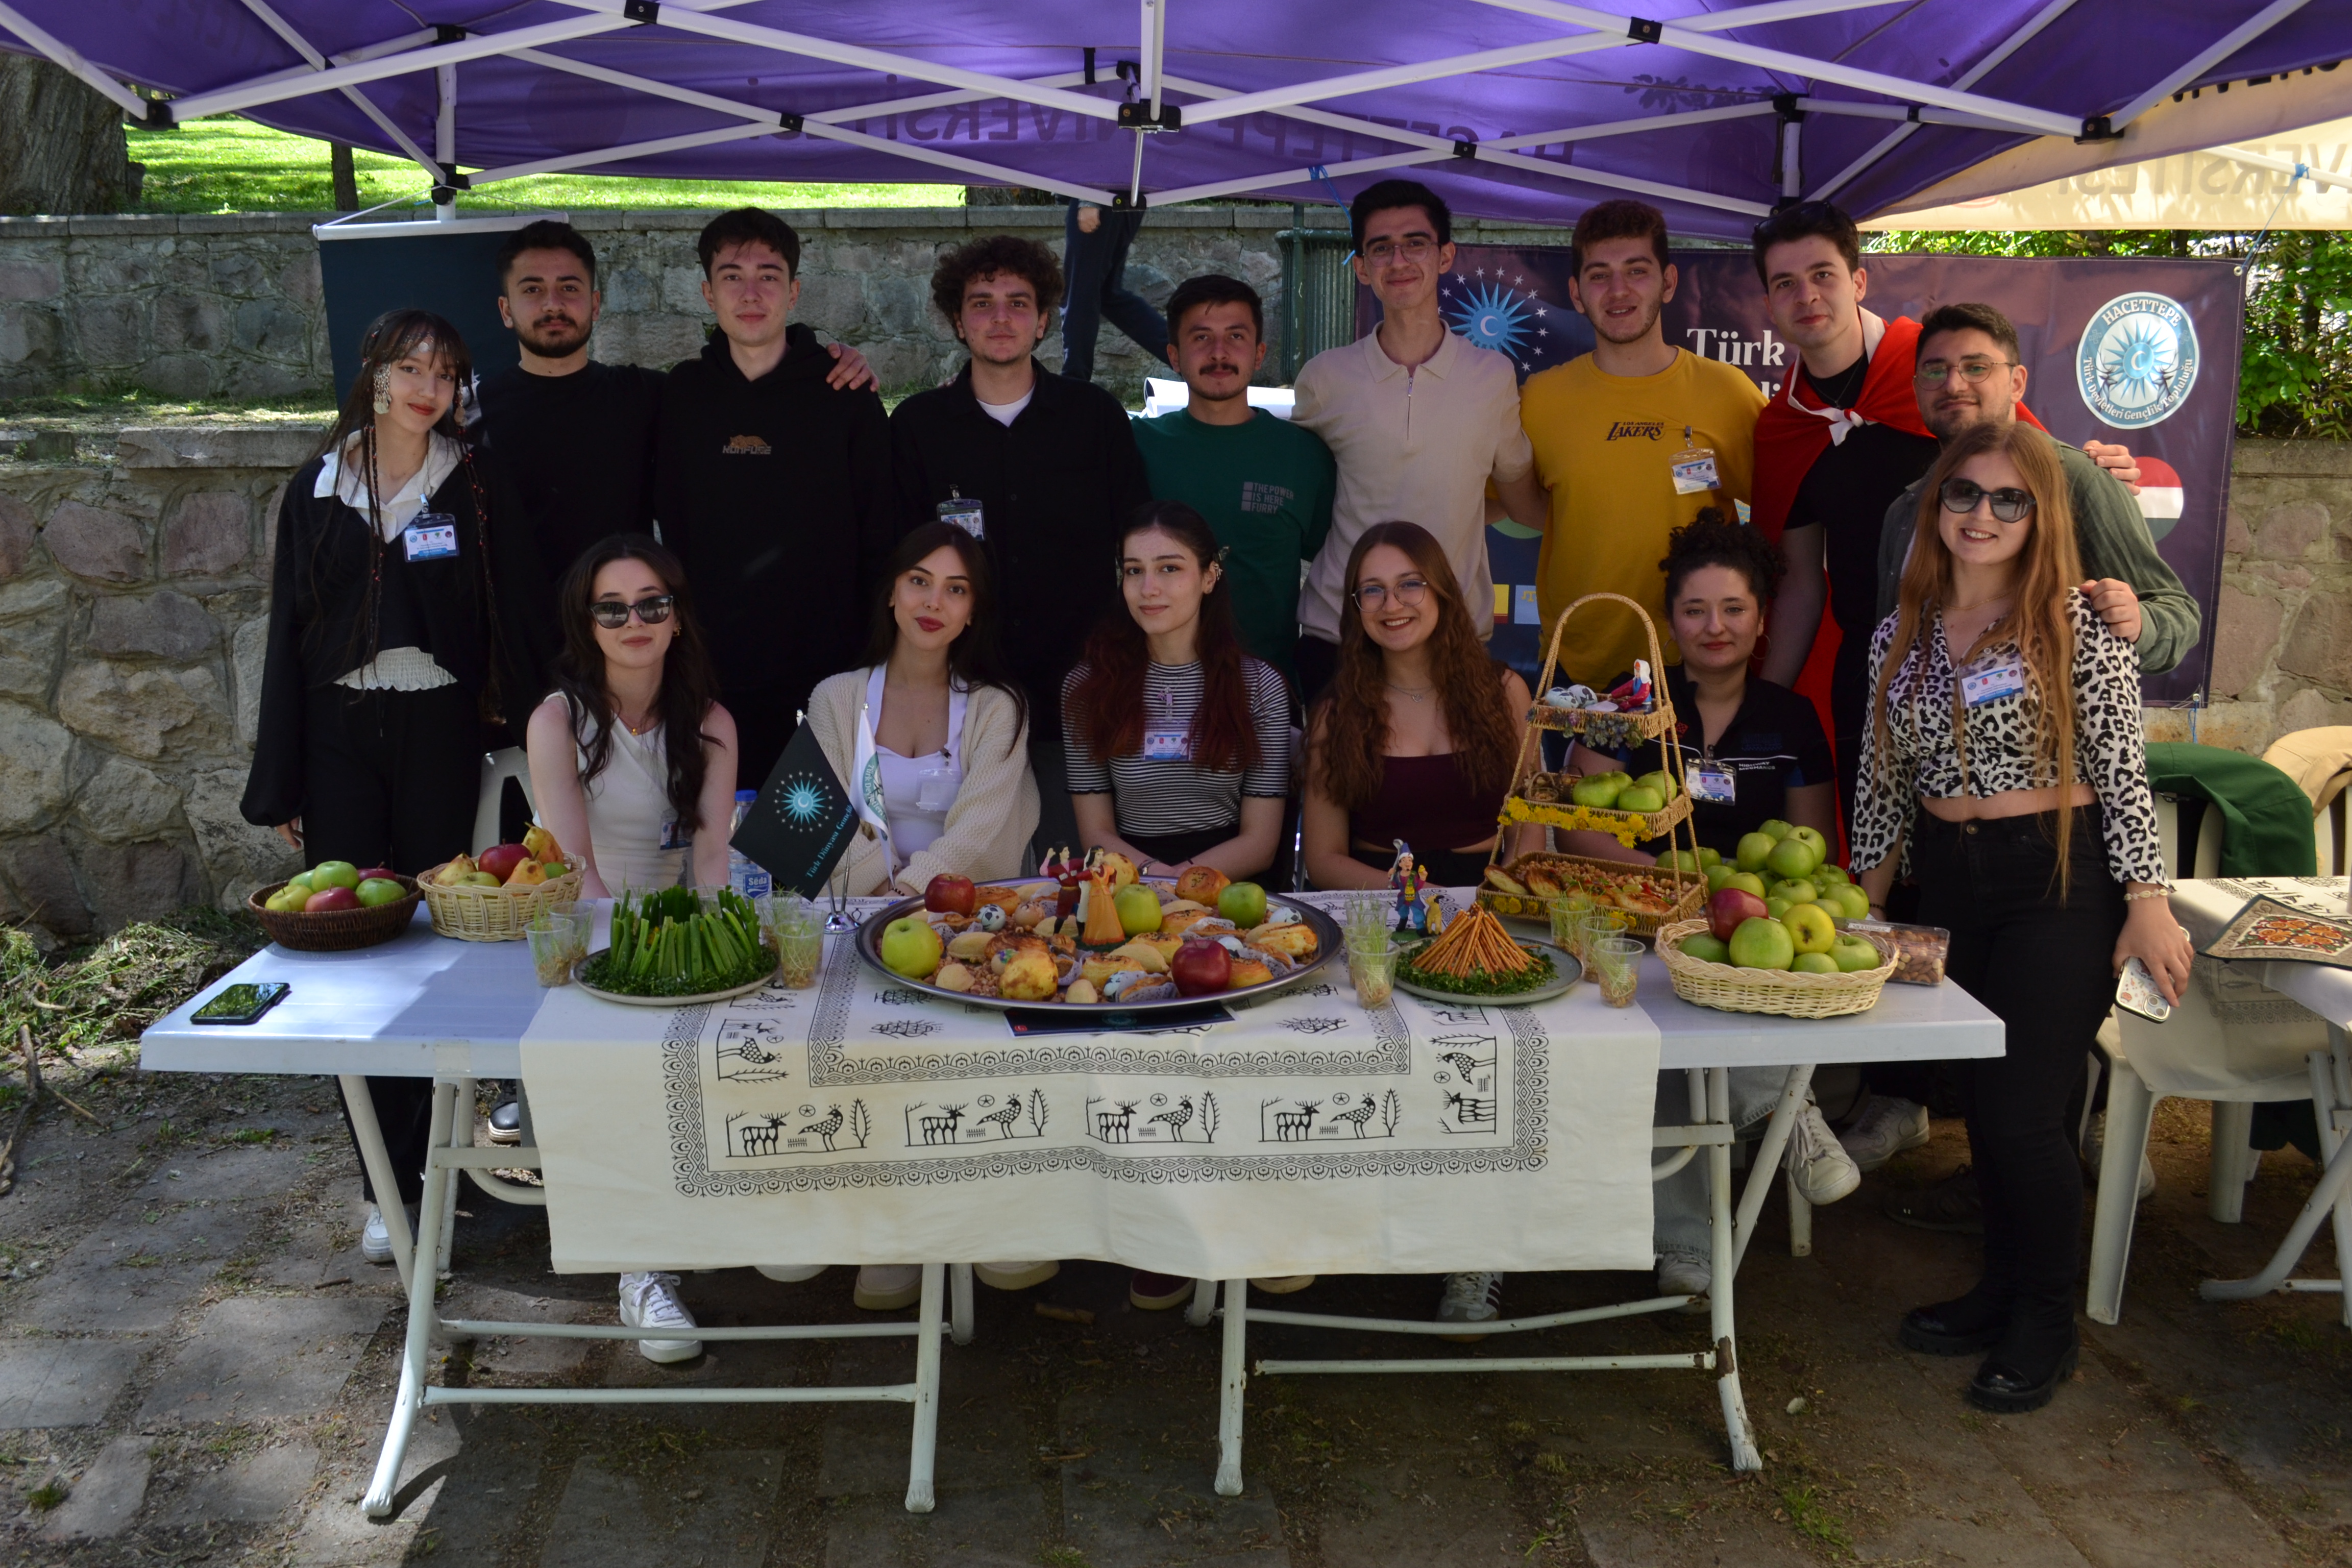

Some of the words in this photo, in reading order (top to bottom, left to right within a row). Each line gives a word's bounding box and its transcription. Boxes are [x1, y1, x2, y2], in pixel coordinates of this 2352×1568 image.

[2101, 299, 2182, 327] HACETTEPE
[1686, 328, 1785, 366] Türk
[2082, 357, 2095, 385] Türk
[2161, 358, 2193, 407] Topluluğu
[2088, 385, 2124, 419] Devletleri
[2124, 404, 2162, 421] Gençlik
[1604, 422, 1665, 441] LAKERS
[1252, 492, 1262, 502] IS
[1264, 494, 1284, 506] HERE
[1254, 483, 1268, 493] THE
[1269, 485, 1294, 500] POWER
[1252, 503, 1279, 514] FURRY
[865, 764, 875, 783] Türk
[805, 860, 822, 878] Türk
